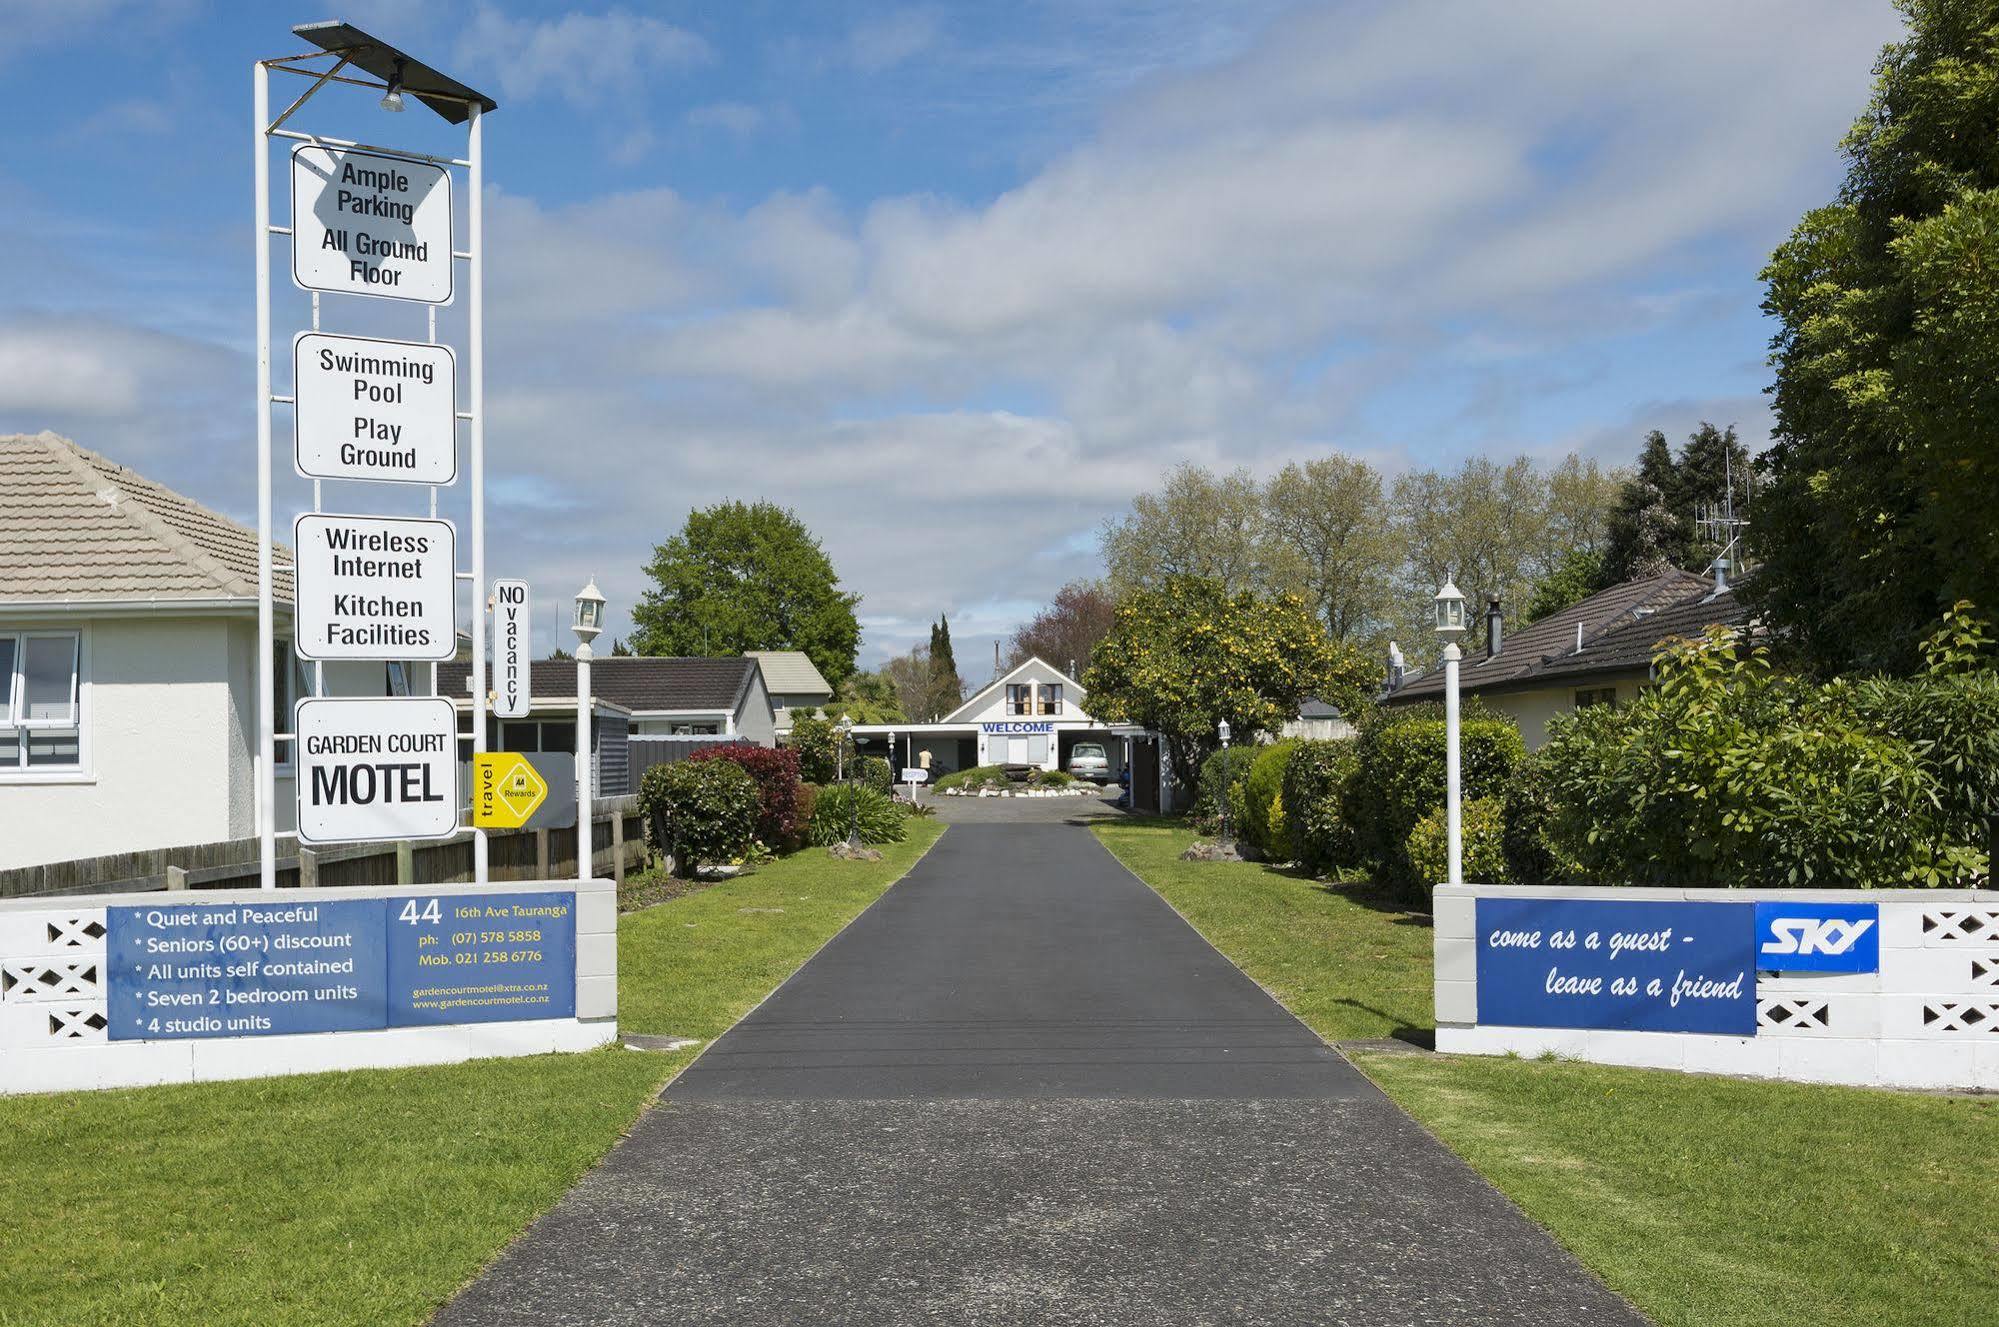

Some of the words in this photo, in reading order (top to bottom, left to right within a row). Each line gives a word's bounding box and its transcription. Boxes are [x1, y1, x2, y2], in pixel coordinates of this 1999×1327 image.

[341, 162, 409, 193] Ample
[338, 190, 414, 225] Parking
[321, 228, 349, 253] All
[355, 231, 428, 263] Ground
[349, 260, 402, 287] Floor
[320, 348, 434, 385] Swimming
[353, 379, 402, 404] Pool
[353, 417, 402, 447] Play
[340, 443, 417, 469] Ground
[325, 527, 429, 554] Wireless
[333, 555, 422, 580] Internet
[334, 594, 423, 618] Kitchen
[499, 586, 525, 604] NO
[327, 623, 430, 646] Facilities
[506, 607, 519, 712] vacancy
[983, 723, 1054, 733] WELCOME
[307, 735, 381, 755] GARDEN
[387, 733, 447, 753] COURT
[311, 763, 444, 806] MOTEL
[481, 763, 493, 817] travel
[147, 911, 197, 929] Quiet
[202, 909, 237, 925] and
[242, 907, 318, 924] Peaceful
[399, 898, 442, 925] 44
[455, 907, 481, 919] 16th
[485, 906, 509, 918] Ave
[512, 905, 568, 919] Tauranga
[147, 937, 214, 953] Seniors
[219, 936, 269, 953] (60+)
[274, 933, 352, 950] discount
[419, 935, 438, 947] ph:
[452, 932, 477, 946] (07)
[481, 931, 504, 944] 578
[508, 930, 541, 942] 5858
[1489, 929, 1541, 950] come
[1549, 934, 1575, 950] as
[1584, 935, 1601, 950] a
[1608, 928, 1671, 960] guest
[1761, 918, 1875, 955] SKY
[147, 964, 171, 980] All
[178, 963, 221, 979] units
[226, 961, 260, 977] self
[263, 958, 353, 976] contained
[419, 954, 451, 966] Mob.
[455, 953, 478, 964] 021
[483, 952, 508, 964] 258
[511, 950, 542, 962] 6776
[147, 991, 203, 1007] Seven
[209, 989, 220, 1004] 2
[226, 989, 308, 1004] bedroom
[314, 984, 358, 1000] units
[1546, 966, 1602, 995] leave
[1610, 979, 1638, 996] as
[1646, 981, 1662, 996] a
[1671, 970, 1743, 1008] friend
[413, 995, 550, 1009] www.gardencourtmotel.co.nz
[148, 1018, 160, 1033] 4
[165, 1016, 222, 1032] studio
[227, 1015, 271, 1030] units
